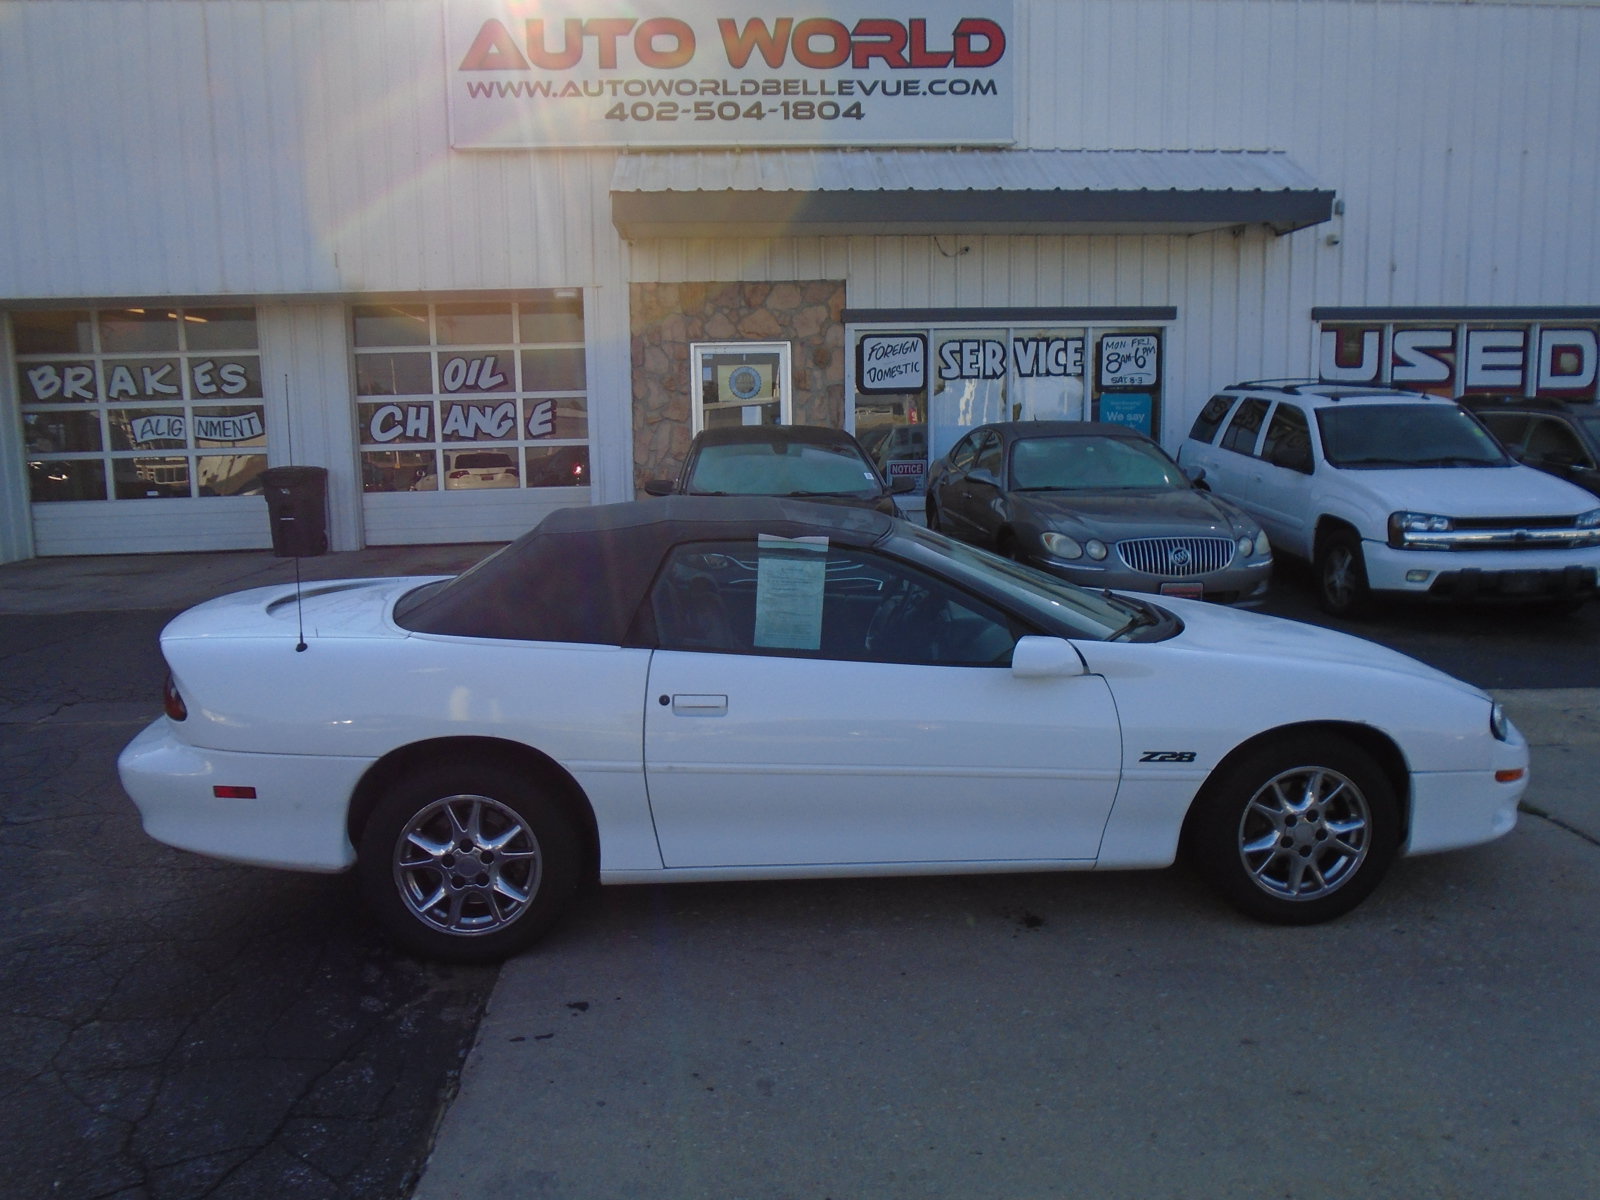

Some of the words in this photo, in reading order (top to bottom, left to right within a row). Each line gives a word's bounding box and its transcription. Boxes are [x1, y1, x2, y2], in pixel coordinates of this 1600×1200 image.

[458, 17, 697, 71] AUTO
[717, 17, 1006, 70] WORLD
[466, 78, 998, 98] WWW.AUTOWORLDBELLEVUE.COM
[604, 101, 866, 121] 402-504-1804
[867, 340, 919, 361] FOREIGN
[1105, 341, 1127, 351] MON
[938, 336, 1085, 380] SERVICE
[1318, 329, 1600, 390] USED
[26, 360, 249, 400] BRAKES
[443, 355, 506, 393] OIL
[866, 361, 920, 383] DOMESTIC
[140, 415, 257, 439] ALIGNMENT
[370, 400, 556, 443] CHANGE
[1107, 411, 1125, 421] We
[1127, 413, 1145, 423] say
[892, 464, 922, 474] NOTICE
[1139, 751, 1197, 762] Z28
